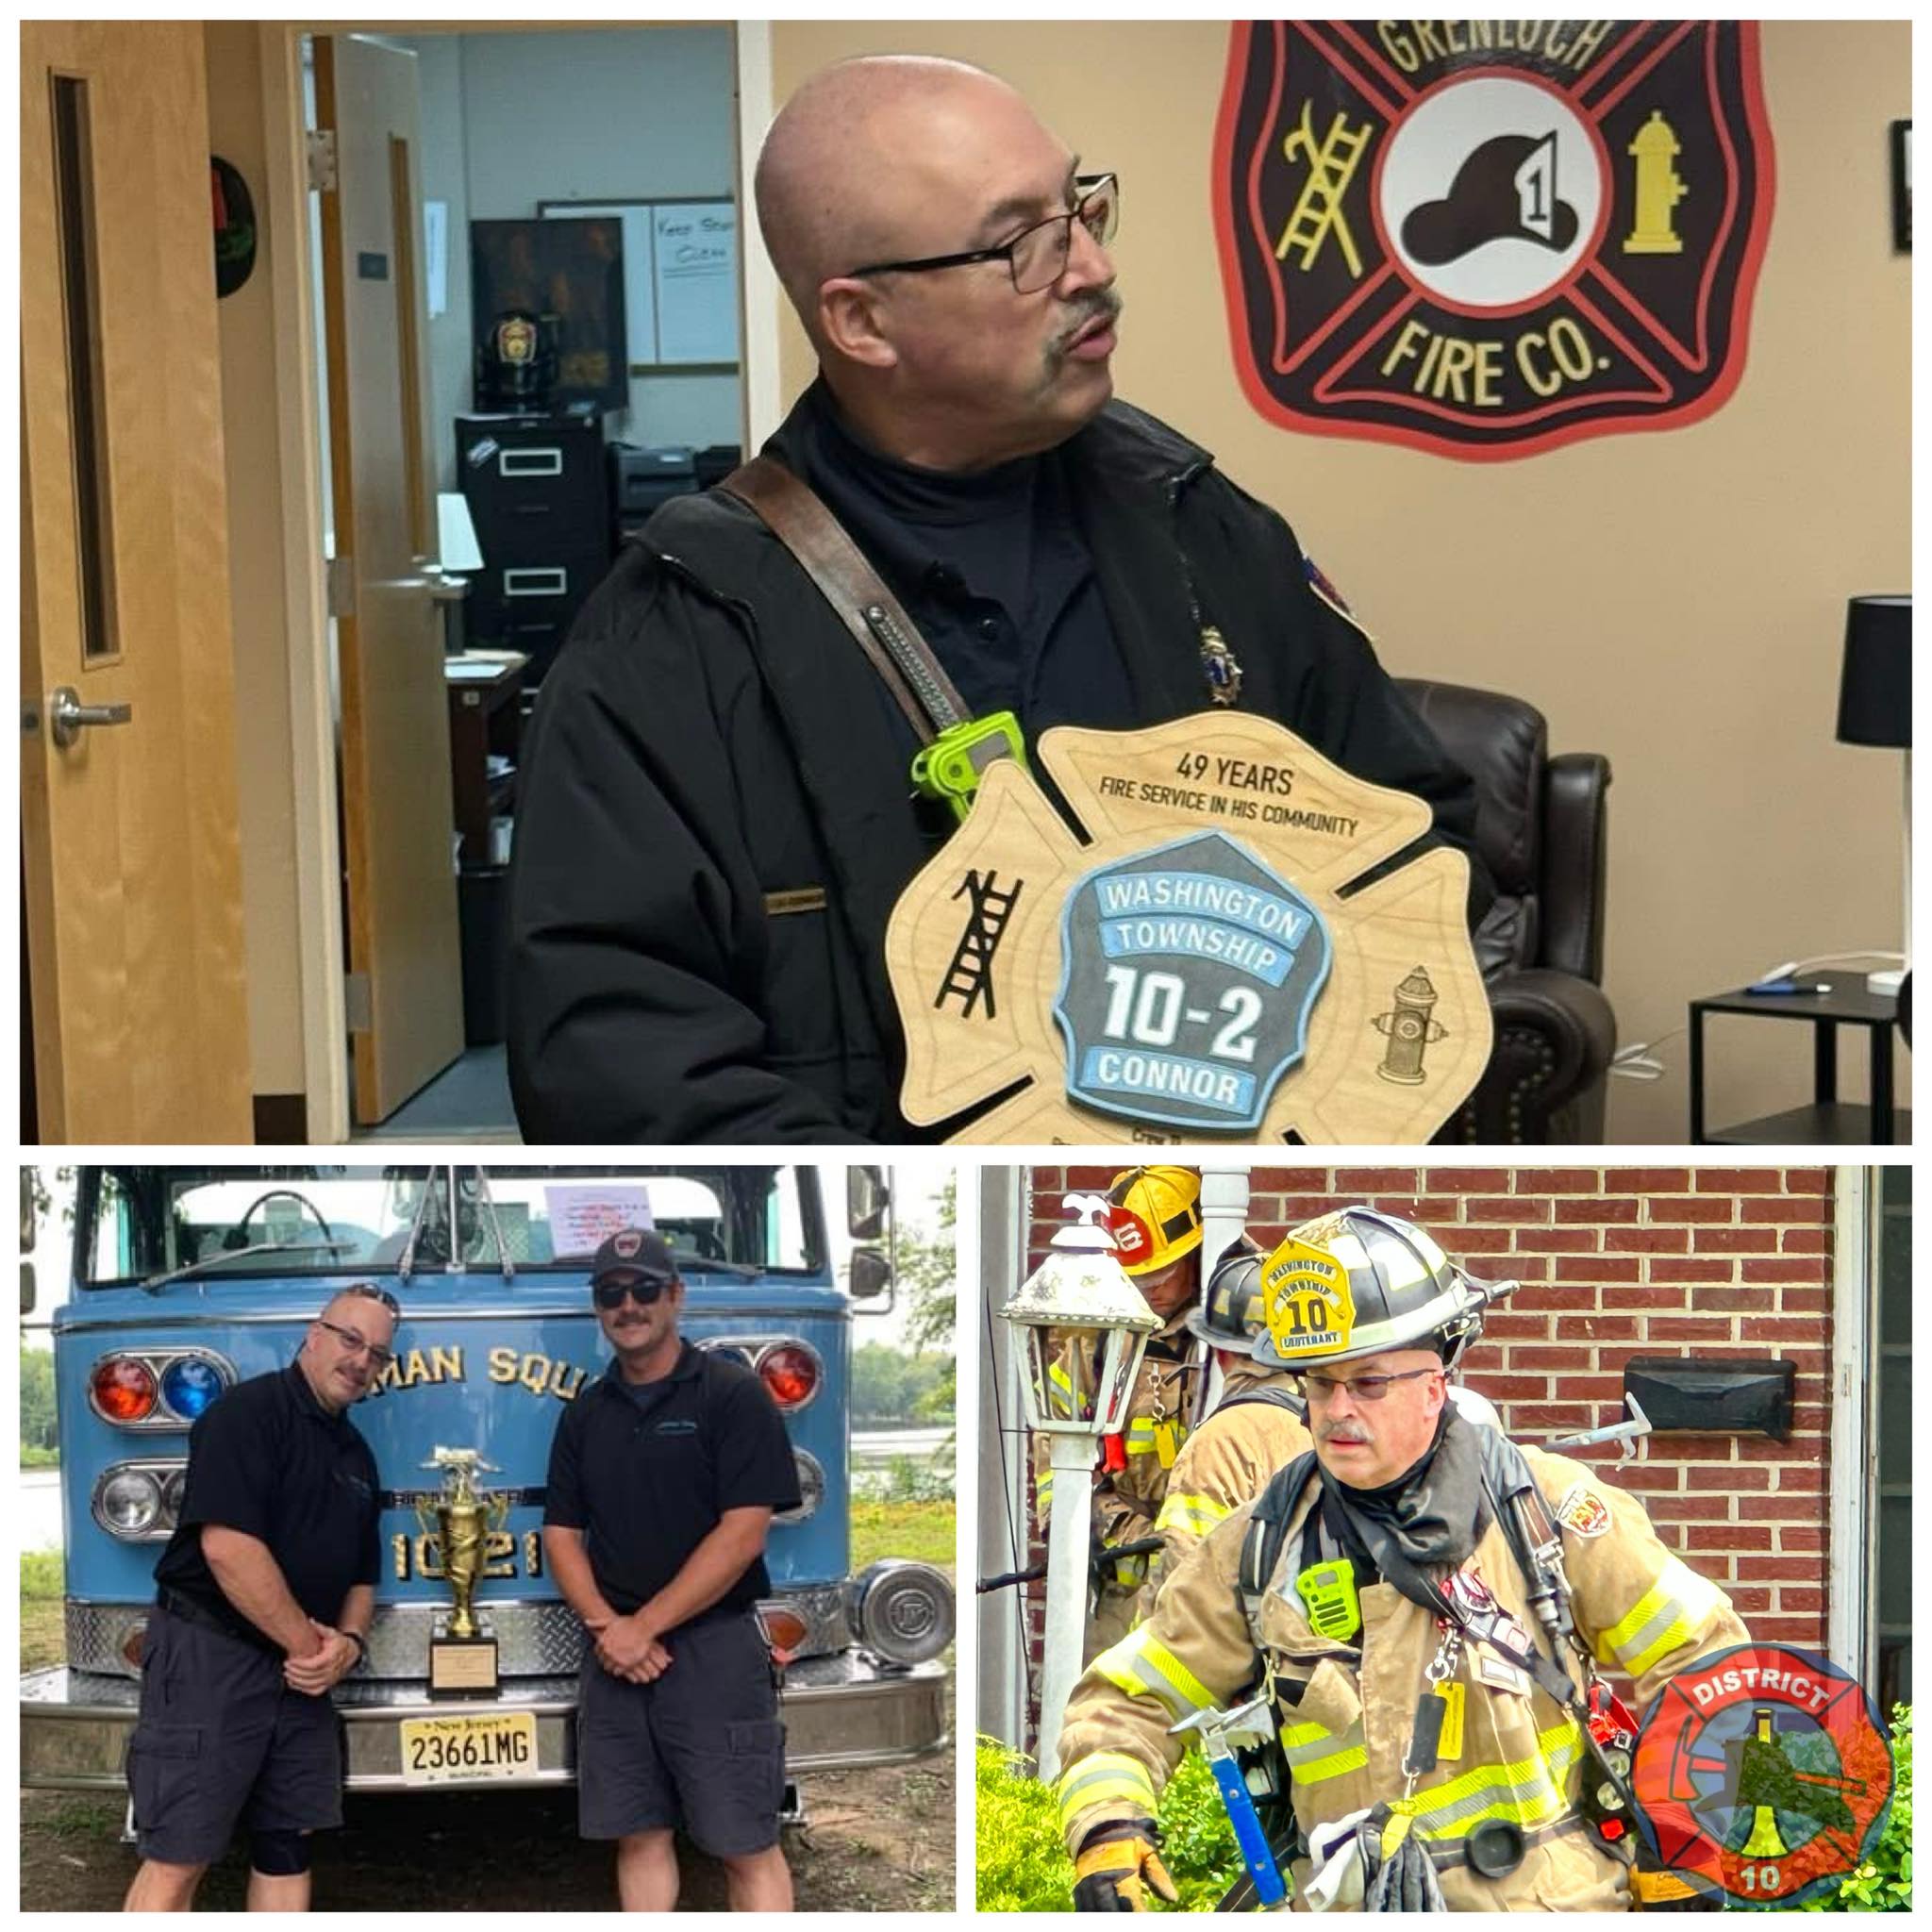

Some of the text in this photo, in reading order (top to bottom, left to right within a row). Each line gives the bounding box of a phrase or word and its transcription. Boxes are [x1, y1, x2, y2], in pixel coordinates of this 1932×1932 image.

[1526, 168, 1547, 222] 1
[1381, 317, 1610, 407] FIRE CO.
[1176, 752, 1294, 795] 49 YEARS
[1099, 775, 1358, 837] FIRE SERVICE IN HIS COMMUNITY
[1108, 878, 1301, 940] WASHINGTON
[1118, 921, 1276, 970] TOWNSHIP
[1105, 964, 1262, 1062] 10-2
[1098, 1053, 1239, 1105] CONNOR
[1287, 1298, 1327, 1334] 10
[370, 1346, 602, 1399] MAN SQU
[411, 1730, 528, 1770] 23661MG
